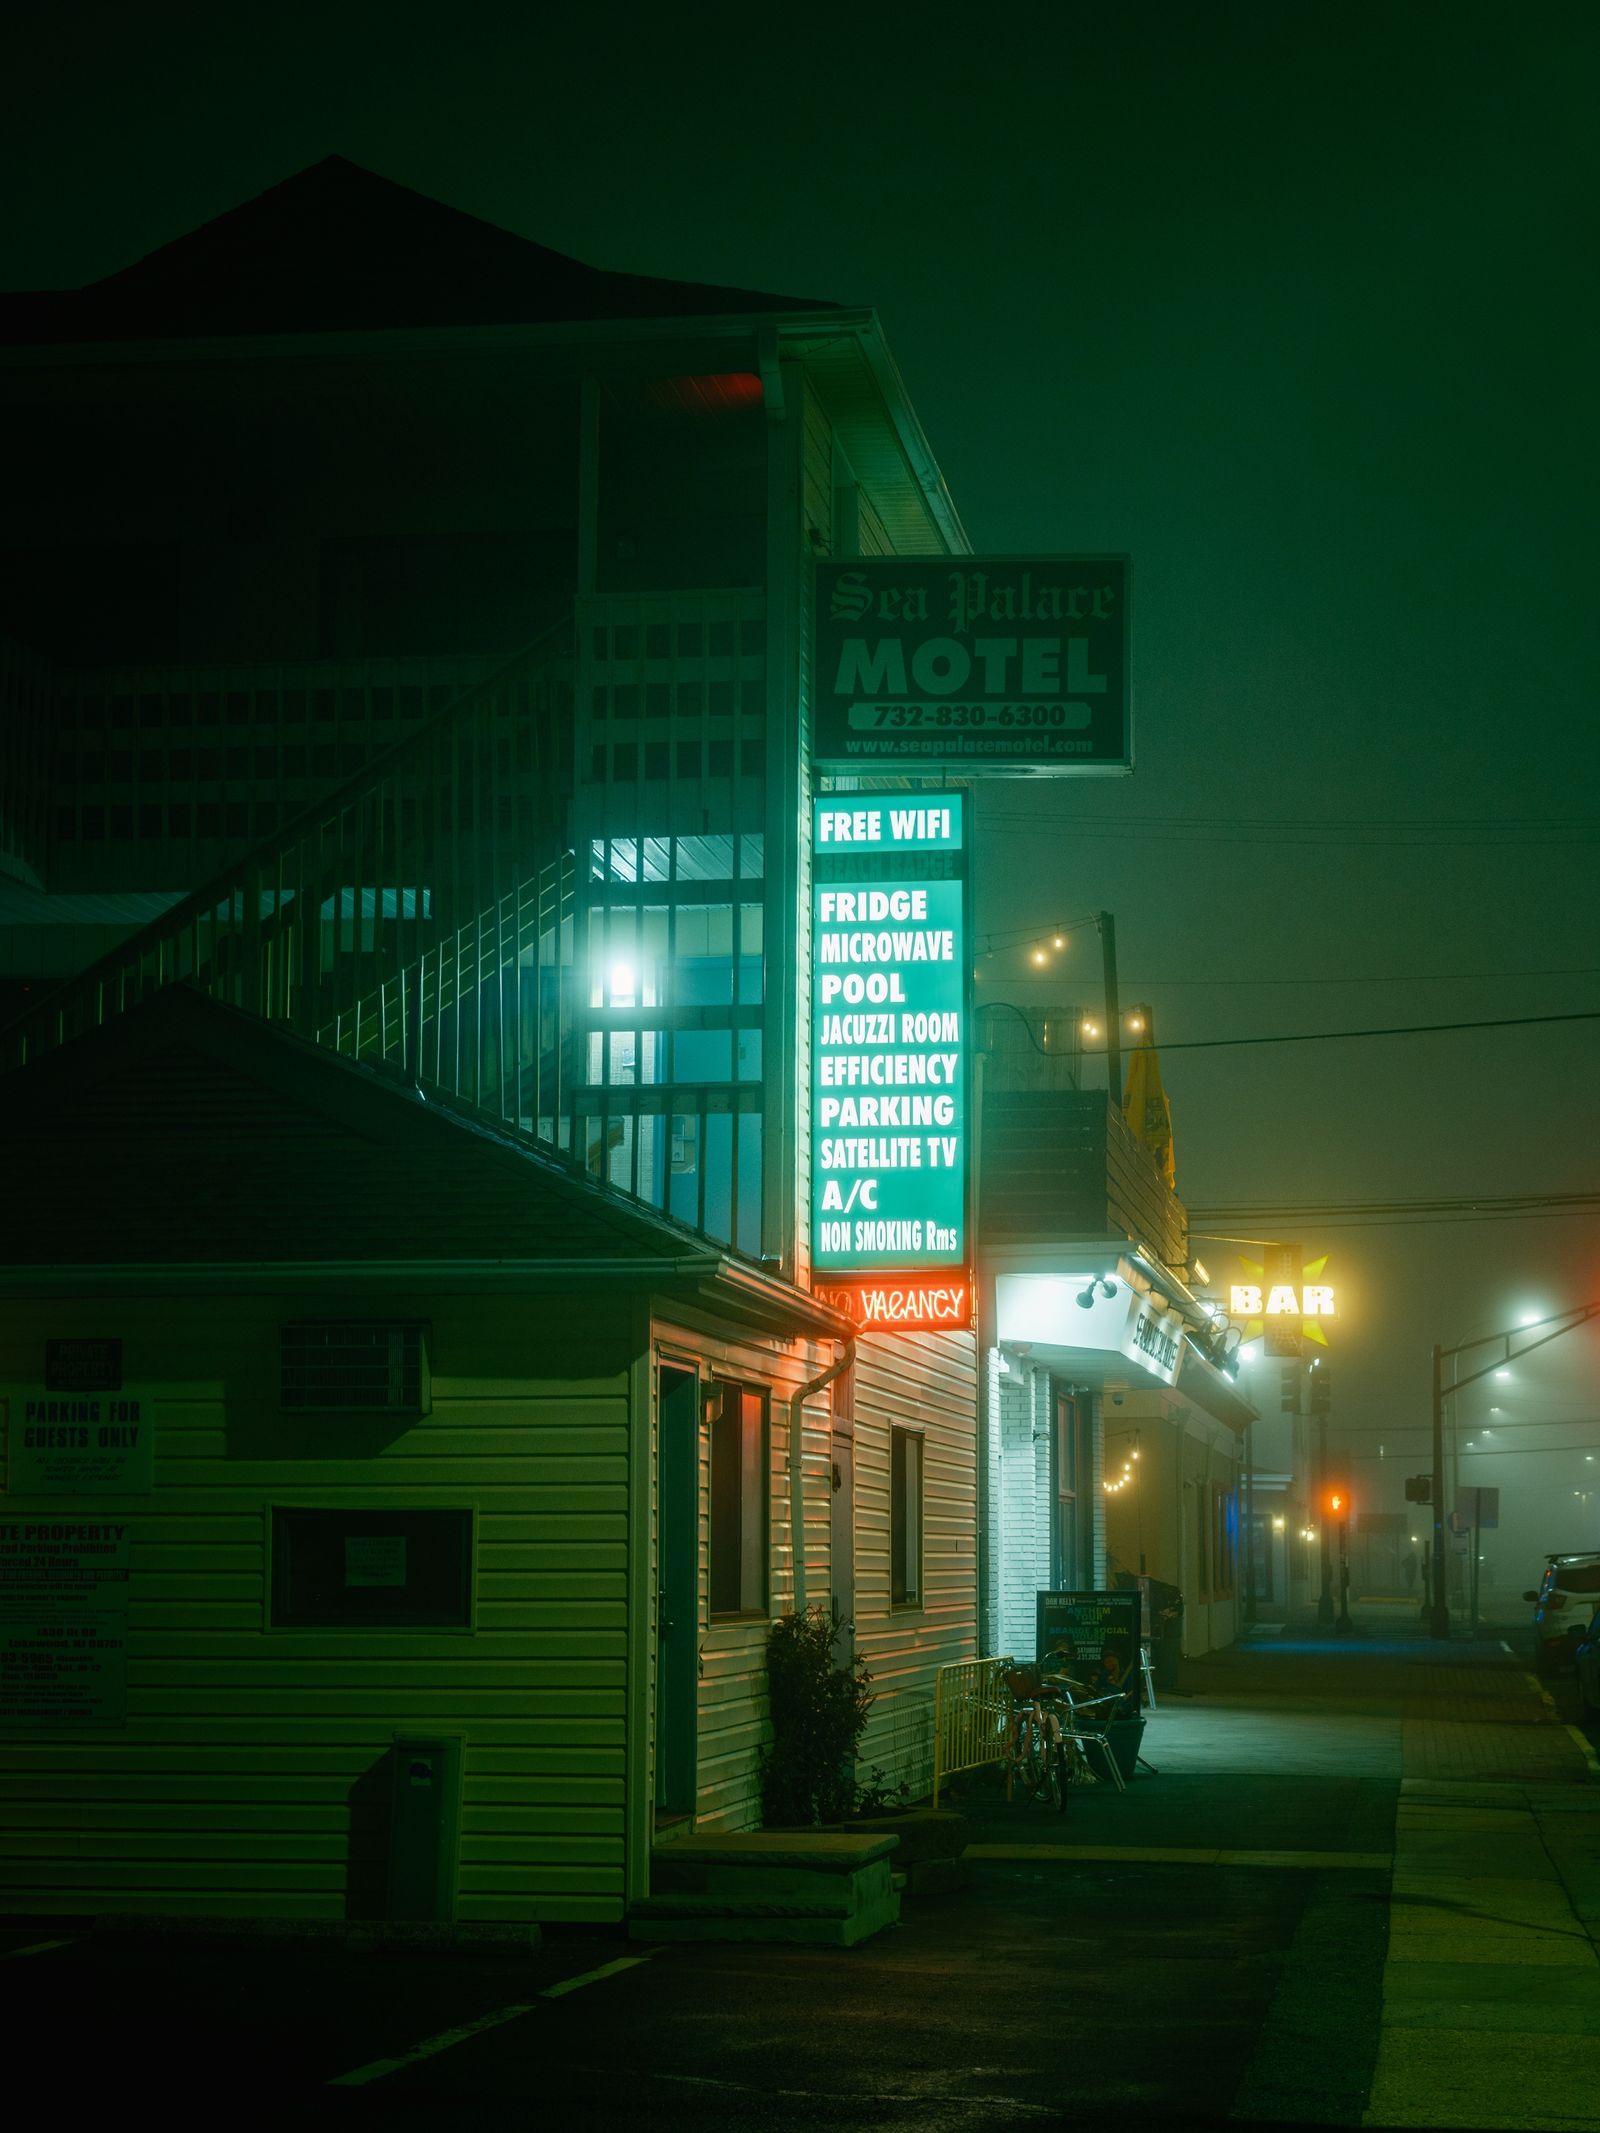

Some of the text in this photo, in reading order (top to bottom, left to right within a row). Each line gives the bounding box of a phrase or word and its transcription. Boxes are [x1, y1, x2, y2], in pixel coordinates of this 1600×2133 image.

[829, 569, 1117, 634] Sea Palace
[833, 637, 1109, 696] MOTEL
[874, 705, 1067, 728] 732-830-6300
[846, 735, 1093, 757] www.seapalacemotel.com
[820, 809, 951, 842] FREE WIFI
[821, 850, 954, 881] BEACH BADGE
[821, 890, 927, 923] FRIDGE
[821, 930, 954, 964] MICROWAVE
[821, 973, 905, 1004] POOL
[821, 1012, 958, 1045] JACUZZI ROOM
[821, 1054, 958, 1086] EFFICIENCY
[821, 1096, 955, 1128] PARKING
[821, 1137, 958, 1169] SATELLITE TV
[821, 1179, 878, 1213] A/C
[821, 1221, 958, 1253] NON SMOKING Rms
[861, 1288, 965, 1320] VACANCY
[1230, 1285, 1335, 1315] BAR
[26, 1401, 140, 1422] PARKING FOR
[24, 1427, 139, 1448] GUESTS ONLY
[20, 1543, 60, 1554] Parking
[62, 1543, 116, 1553] Prohibited
[24, 1525, 125, 1540] PROPERTY
[1094, 1626, 1129, 1634] SOCIAL
